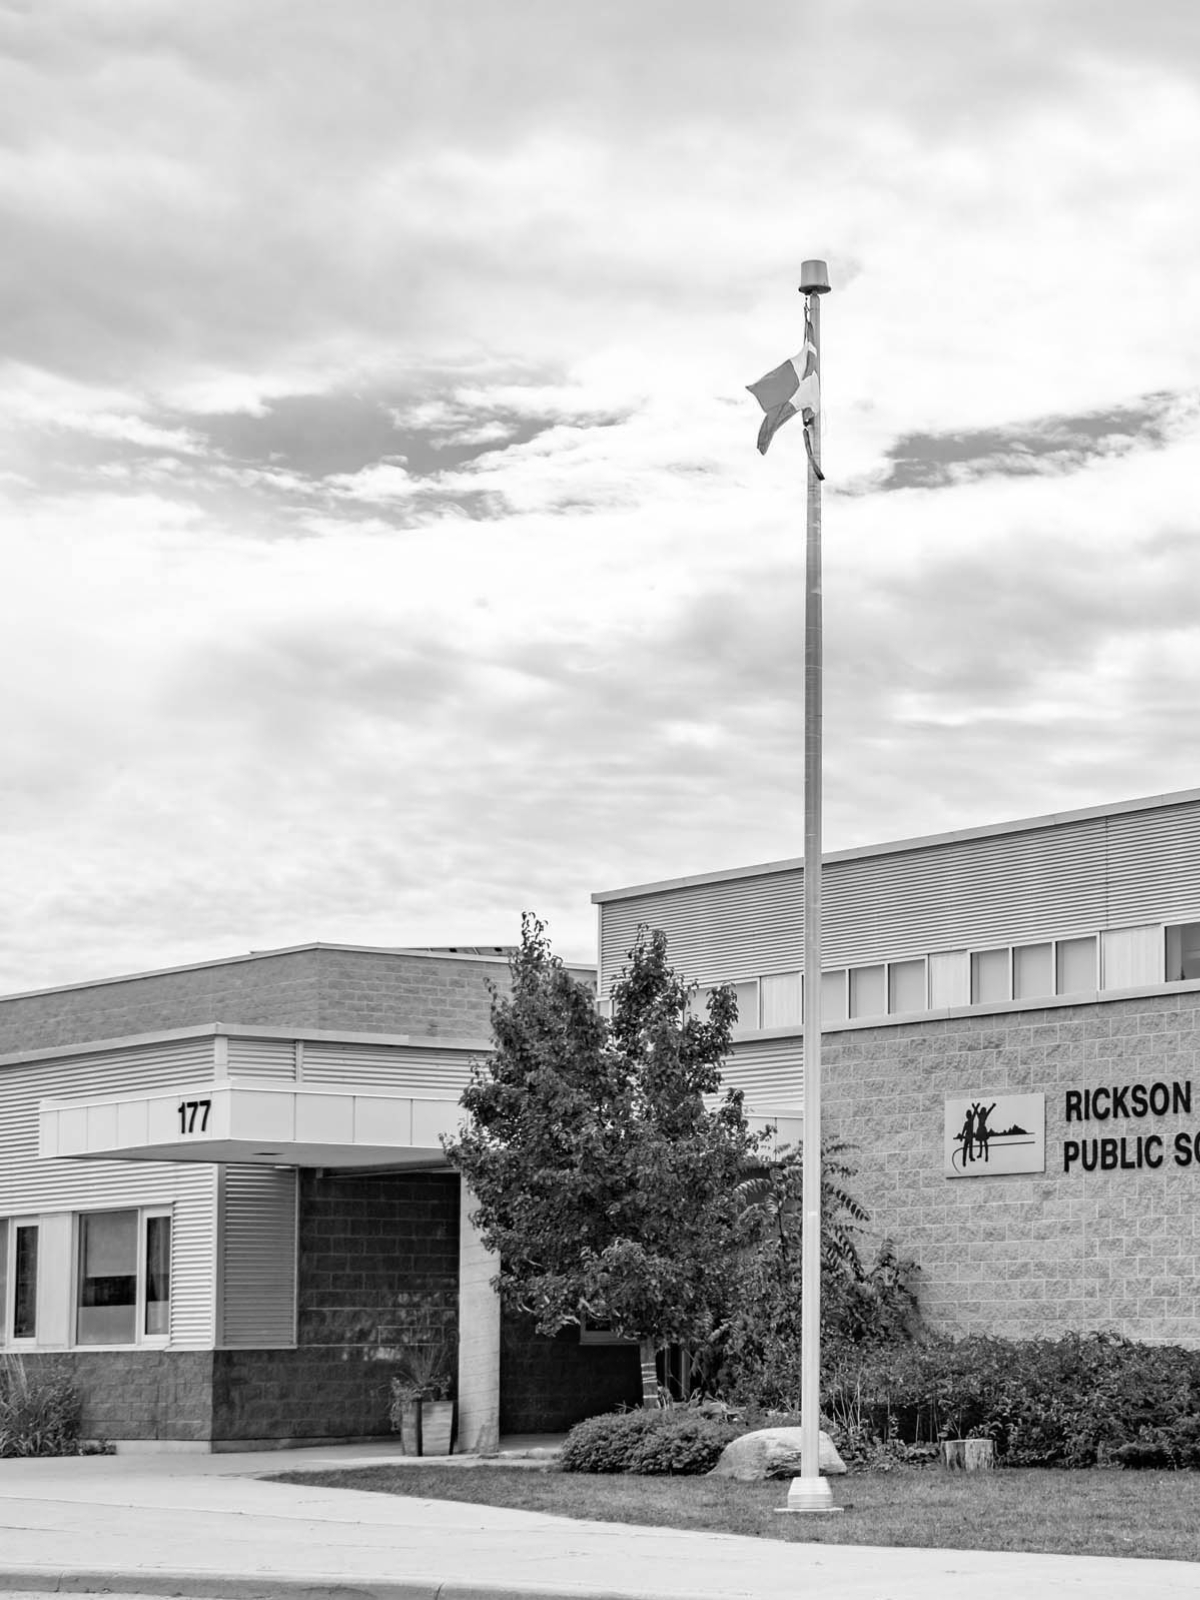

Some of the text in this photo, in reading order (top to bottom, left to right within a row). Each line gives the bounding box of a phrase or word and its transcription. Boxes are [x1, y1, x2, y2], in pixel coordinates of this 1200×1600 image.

[178, 1099, 212, 1134] 177
[1065, 1080, 1192, 1123] RICKSON
[1063, 1134, 1164, 1173] PUBLIC
